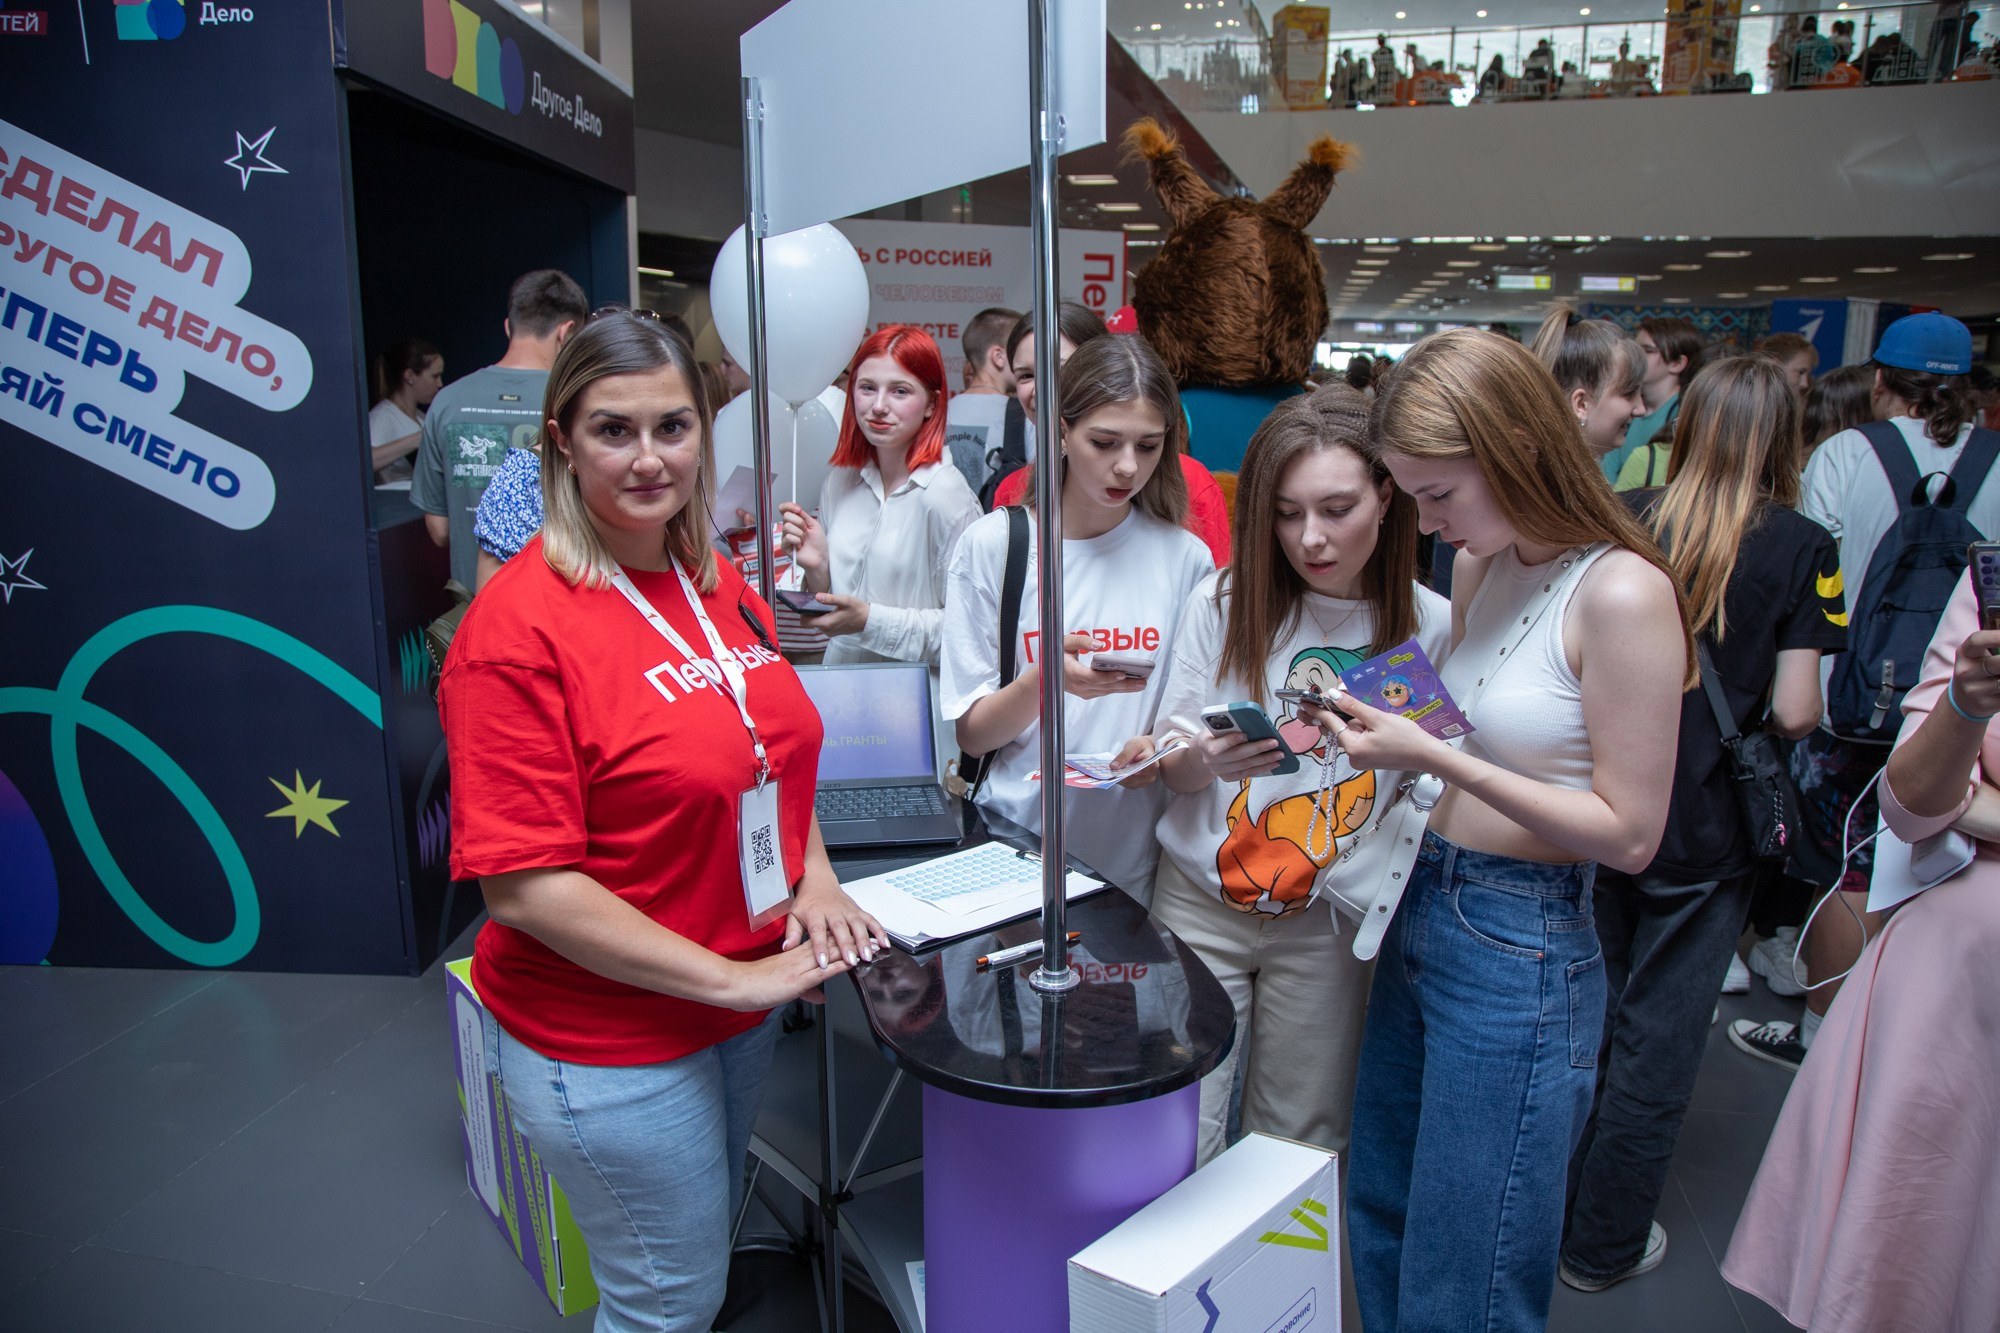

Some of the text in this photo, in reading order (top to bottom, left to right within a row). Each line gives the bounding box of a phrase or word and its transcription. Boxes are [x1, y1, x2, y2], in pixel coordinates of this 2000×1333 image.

[199, 1, 254, 25] Дело
[531, 70, 602, 137] Другое Дело
[876, 247, 890, 264] С
[895, 247, 992, 267] РОССИЕЙ
[875, 283, 1005, 304] ЧЕЛОВЕКОМ
[0, 286, 158, 393] ПЕРЬ
[138, 295, 283, 392] ДЕЛО,
[877, 322, 959, 338] СТЕ
[1926, 361, 1959, 371] OFF-WHITE
[0, 362, 241, 499] ЯЙ СМЕЛО
[1023, 626, 1160, 664] Пвые
